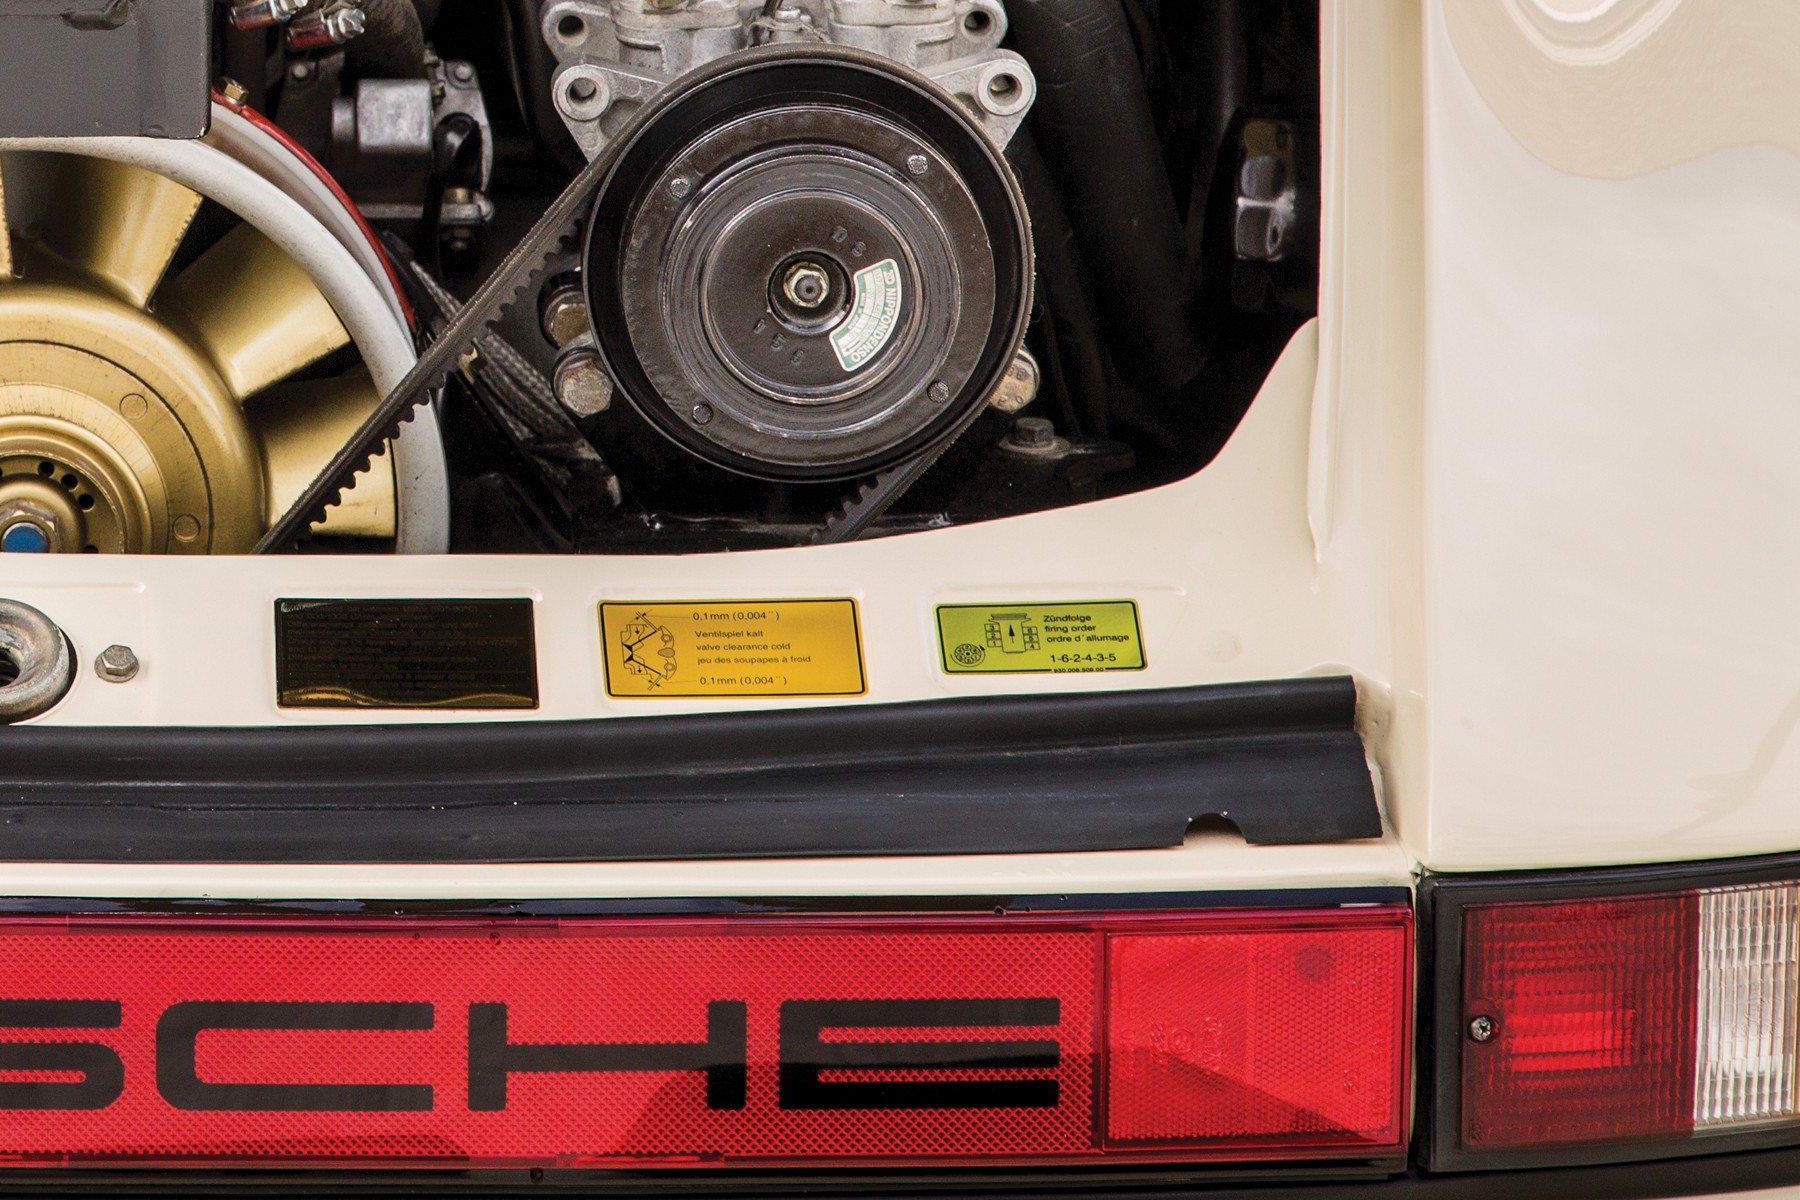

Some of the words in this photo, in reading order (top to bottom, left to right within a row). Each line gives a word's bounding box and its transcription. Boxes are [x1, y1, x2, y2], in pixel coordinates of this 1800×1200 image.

[850, 288, 897, 362] NIPPONDENSO
[697, 657, 712, 665] jeu
[1050, 653, 1117, 663] 1-6-2-4-3-5
